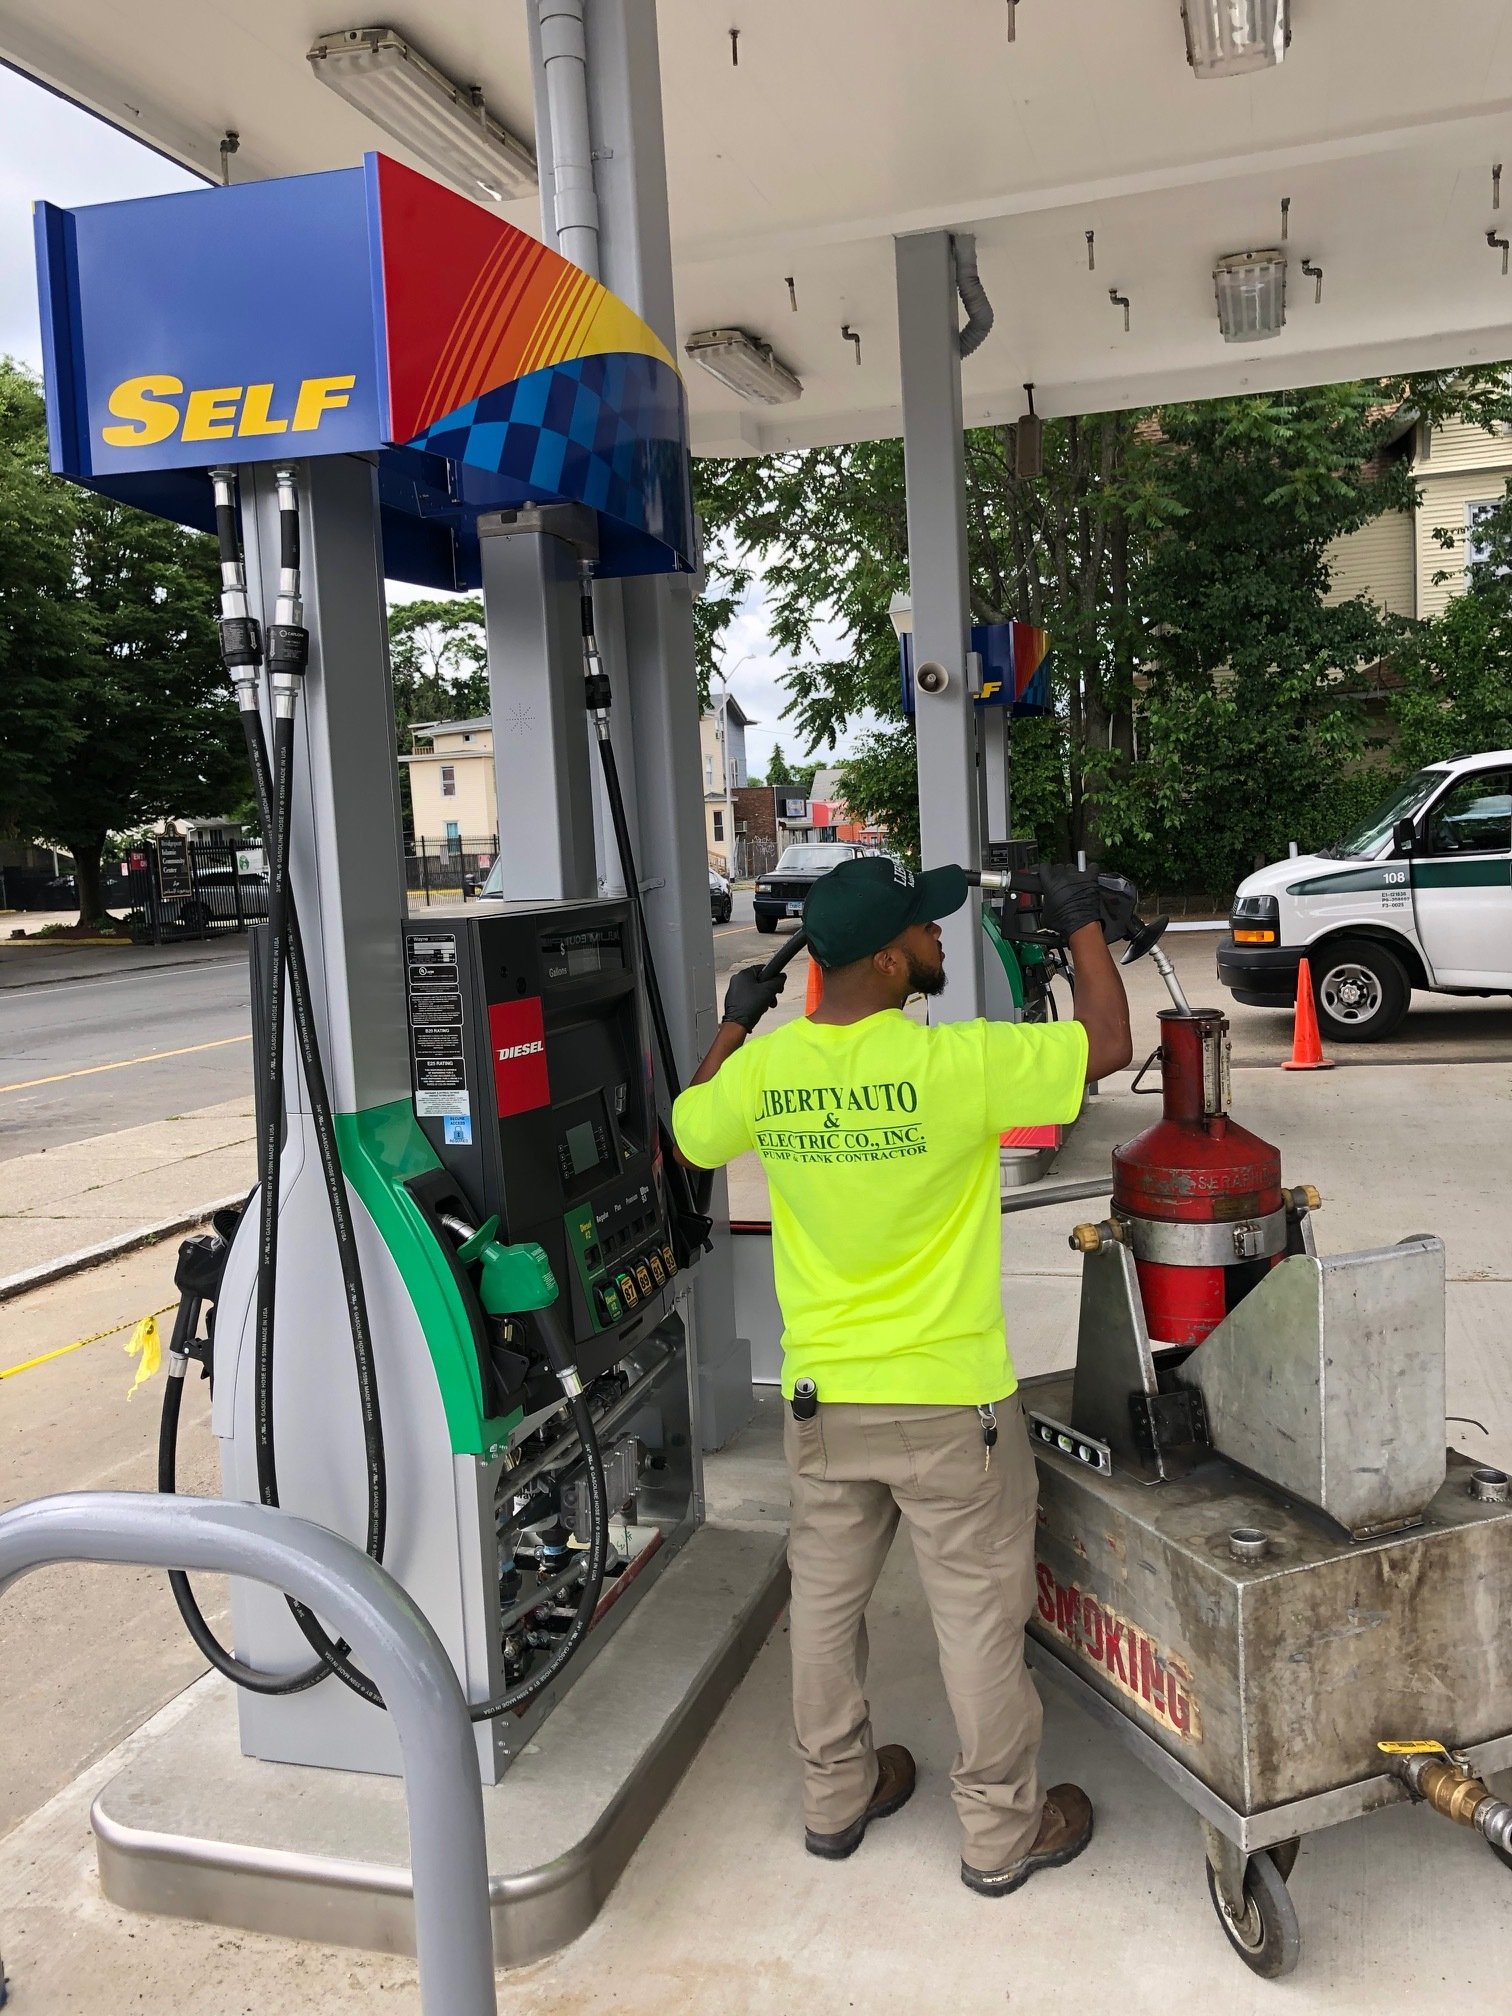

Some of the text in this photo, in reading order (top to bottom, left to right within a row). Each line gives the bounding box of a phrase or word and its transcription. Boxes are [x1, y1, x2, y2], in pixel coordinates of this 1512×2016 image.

[102, 374, 356, 446] SELF
[1383, 872, 1406, 884] 108
[548, 967, 568, 978] Gallons
[496, 1041, 544, 1060] DIESEL
[755, 1082, 918, 1121] LIBERTY AUTO
[824, 1112, 840, 1128] &
[757, 1128, 925, 1150] ELECTRIC CO., INC.
[764, 1151, 790, 1160] PUMP
[802, 1154, 833, 1164] TANK
[836, 1145, 928, 1163] CONTRACTOR
[579, 1219, 592, 1232] Diesel
[666, 1254, 674, 1268] 93
[654, 1264, 662, 1278] 91
[640, 1274, 650, 1290] 89
[624, 1284, 634, 1300] 87
[1037, 1562, 1191, 1734] SMOKING
[324, 1650, 334, 1662] USA
[551, 1646, 570, 1671] GASOLINE
[337, 1665, 351, 1680] MADE
[540, 1668, 552, 1682] HOSE
[483, 1706, 495, 1715] USA
[502, 1698, 517, 1708] MADE
